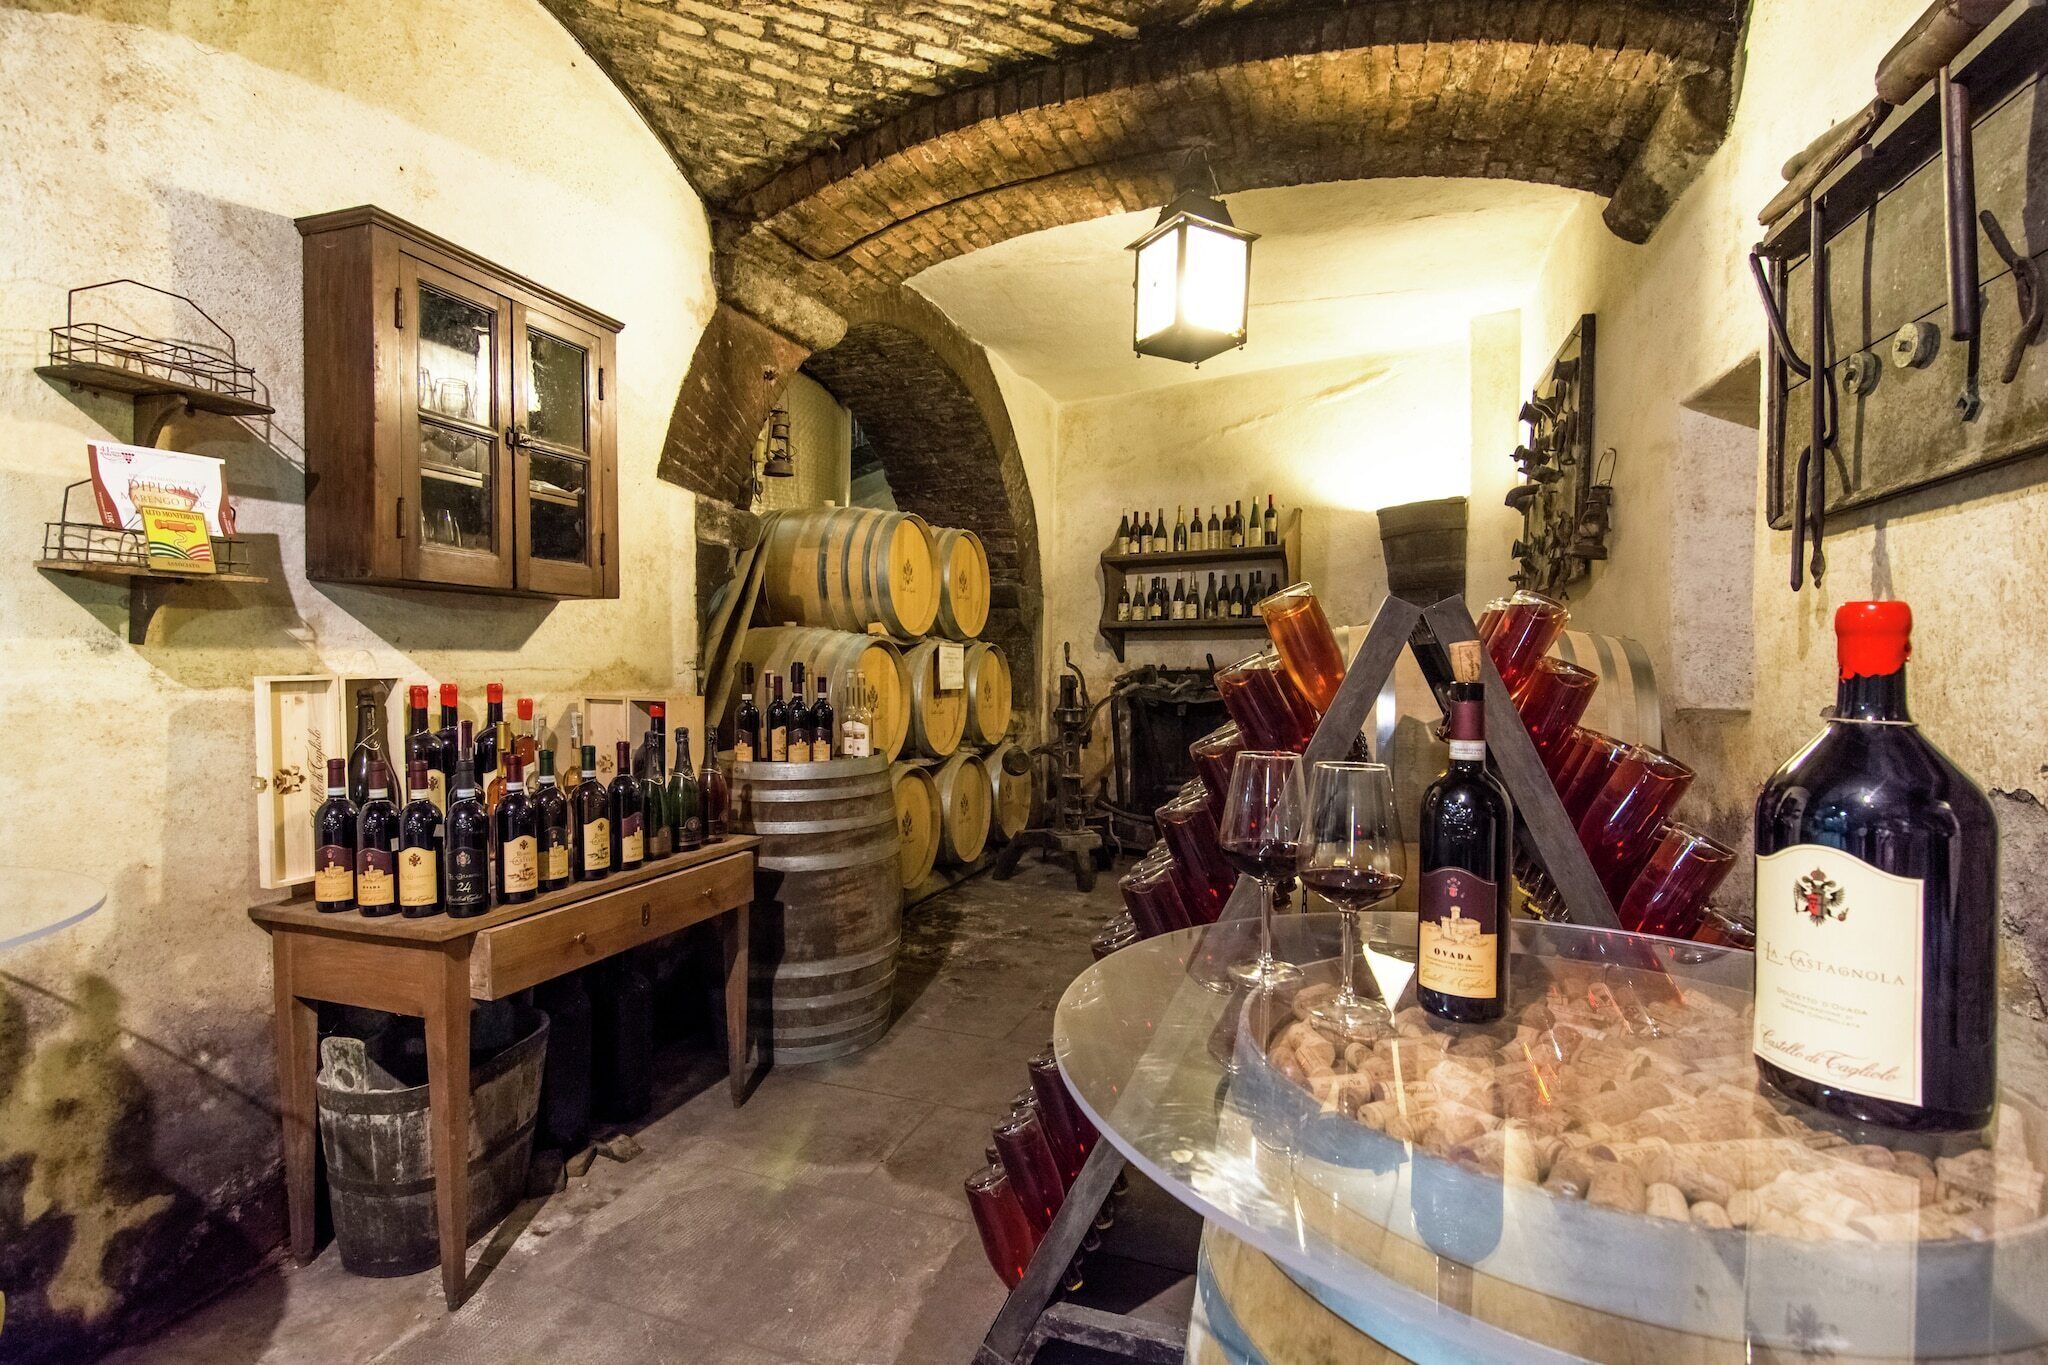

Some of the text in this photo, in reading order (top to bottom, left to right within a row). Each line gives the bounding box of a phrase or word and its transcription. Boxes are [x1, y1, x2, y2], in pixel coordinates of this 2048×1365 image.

[145, 508, 161, 516] ALTO
[456, 881, 472, 893] 24
[1433, 947, 1473, 961] OVADA
[1784, 950, 1906, 987] CASTAGNOLA
[1761, 1024, 1901, 1082] Castello di Tagliolo
